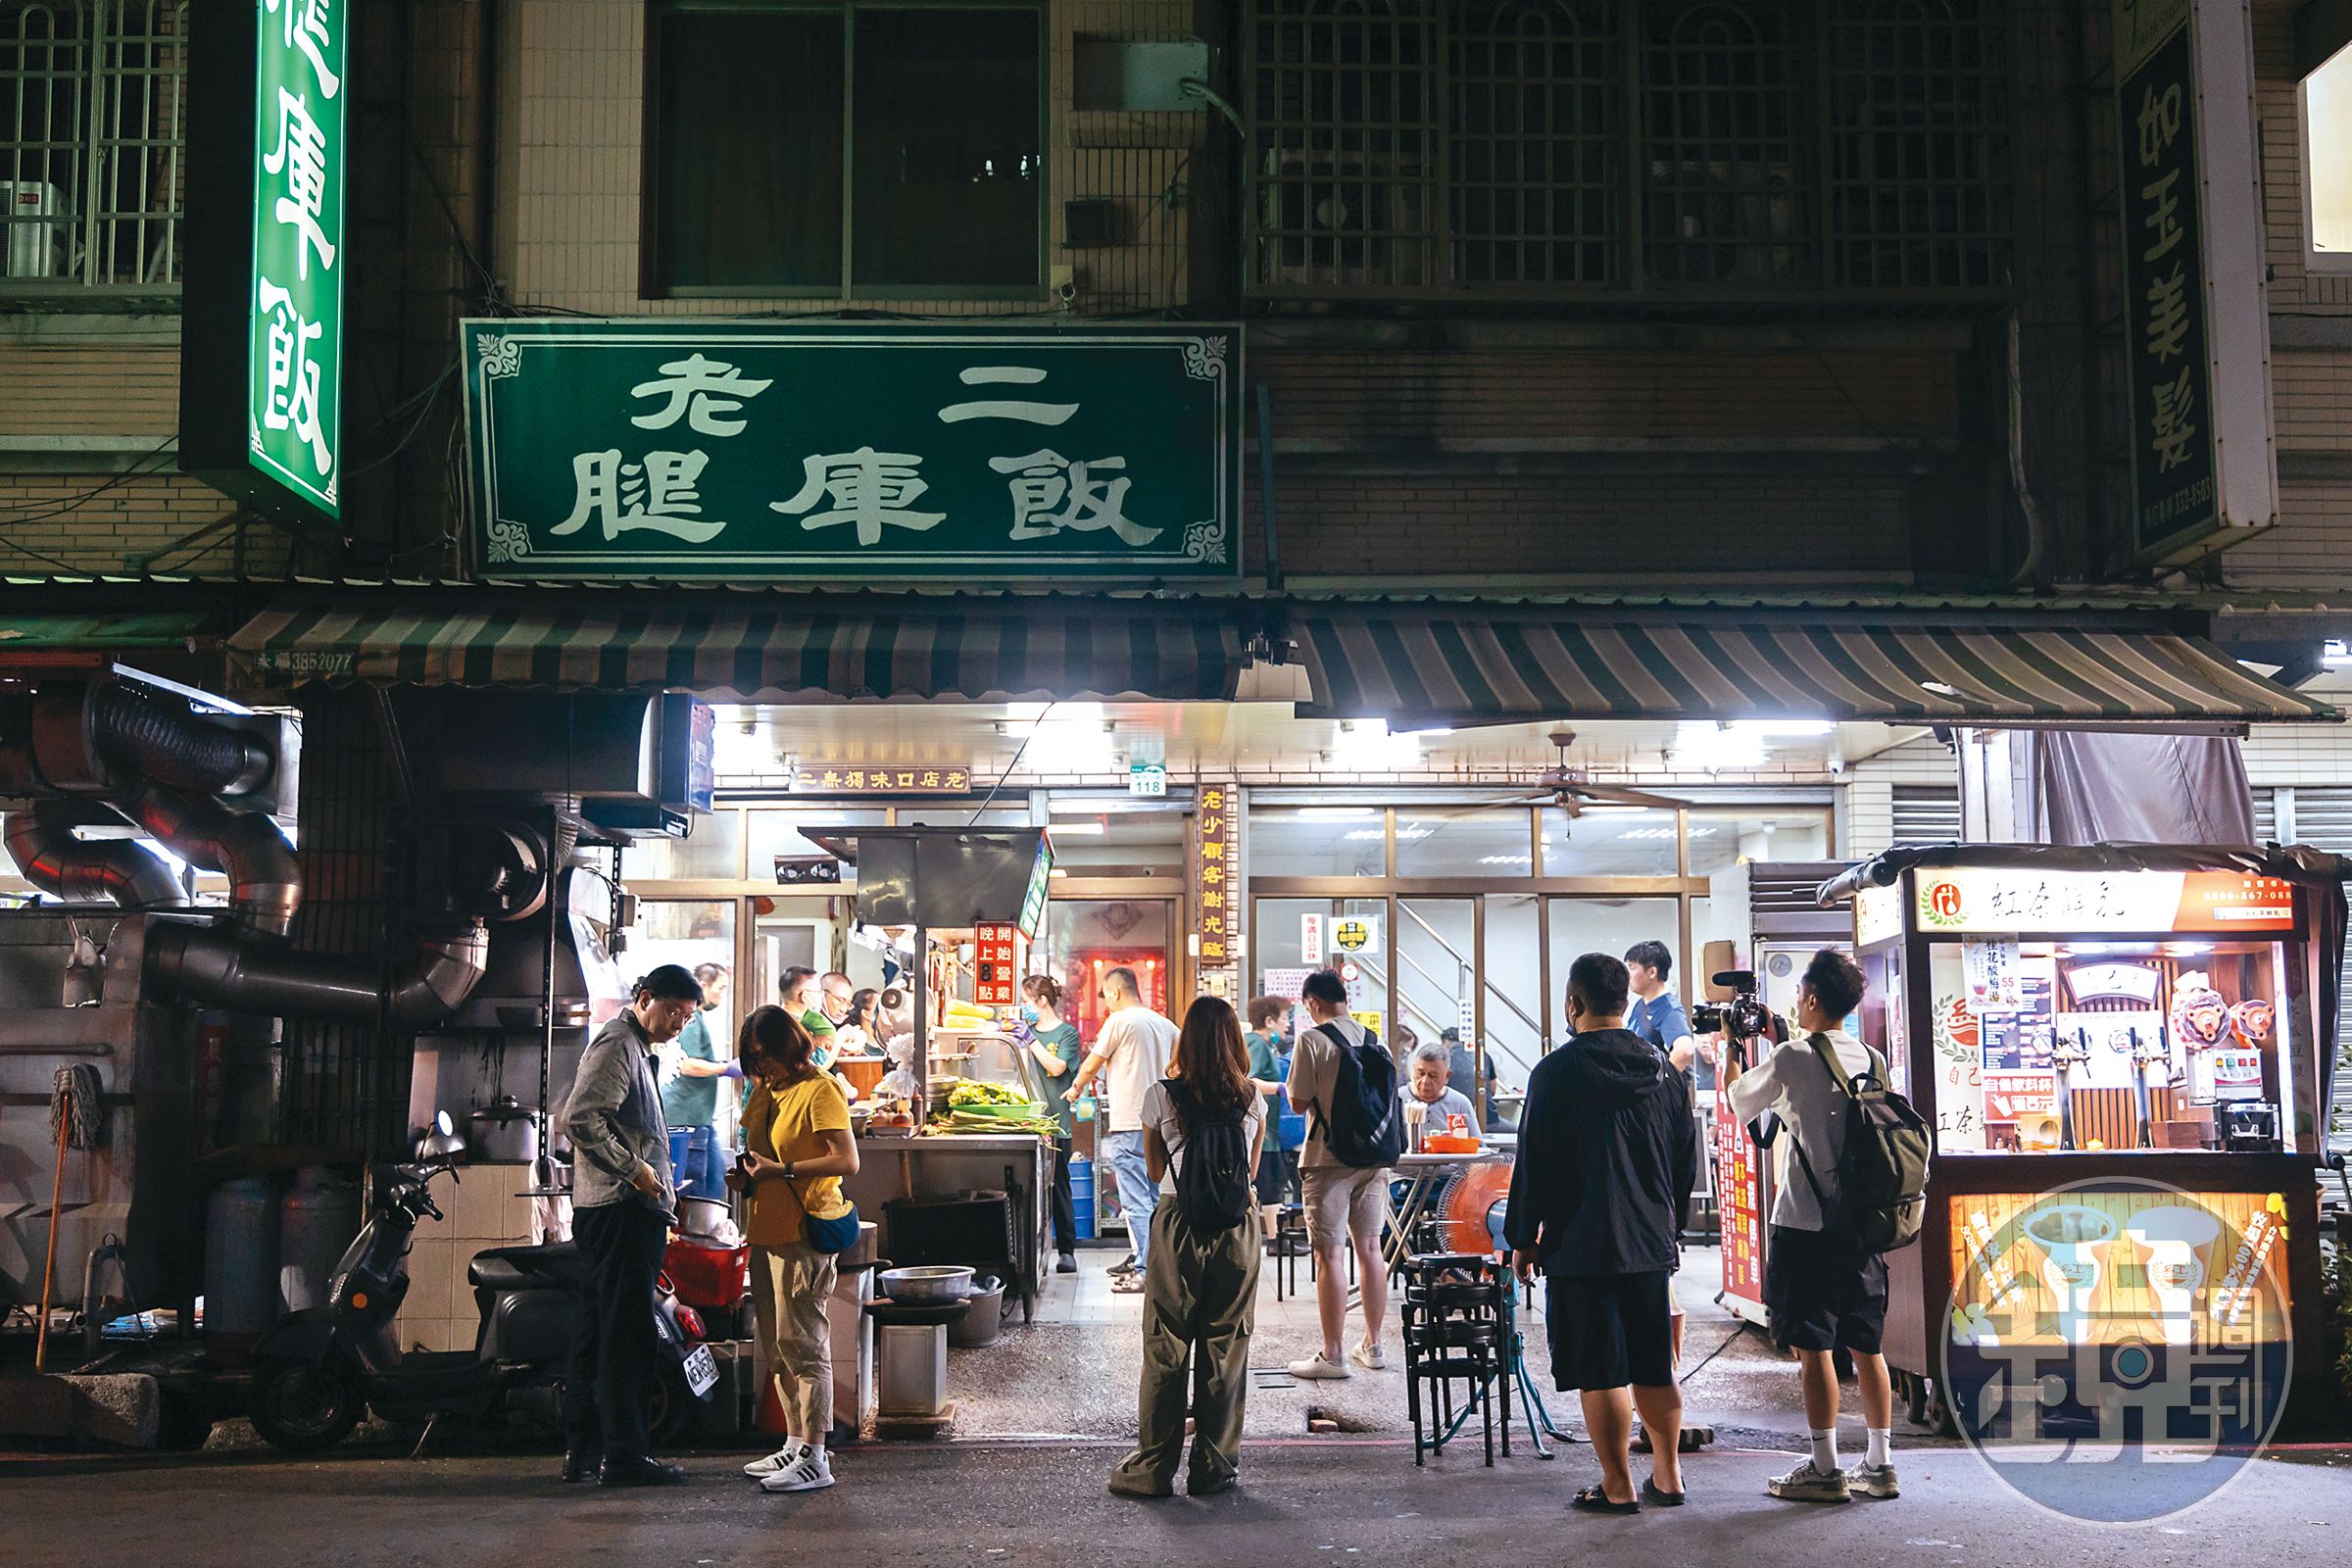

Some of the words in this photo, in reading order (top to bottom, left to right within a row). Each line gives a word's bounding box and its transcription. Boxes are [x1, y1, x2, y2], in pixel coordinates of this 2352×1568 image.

[550, 446, 1164, 547] 腿庫飯
[1136, 781, 1160, 793] 118
[979, 927, 995, 1001] 晚上8點
[996, 927, 1012, 1001] 開始營業
[1985, 938, 2000, 1004] 桂花酸梅湯
[2001, 977, 2014, 988] 55
